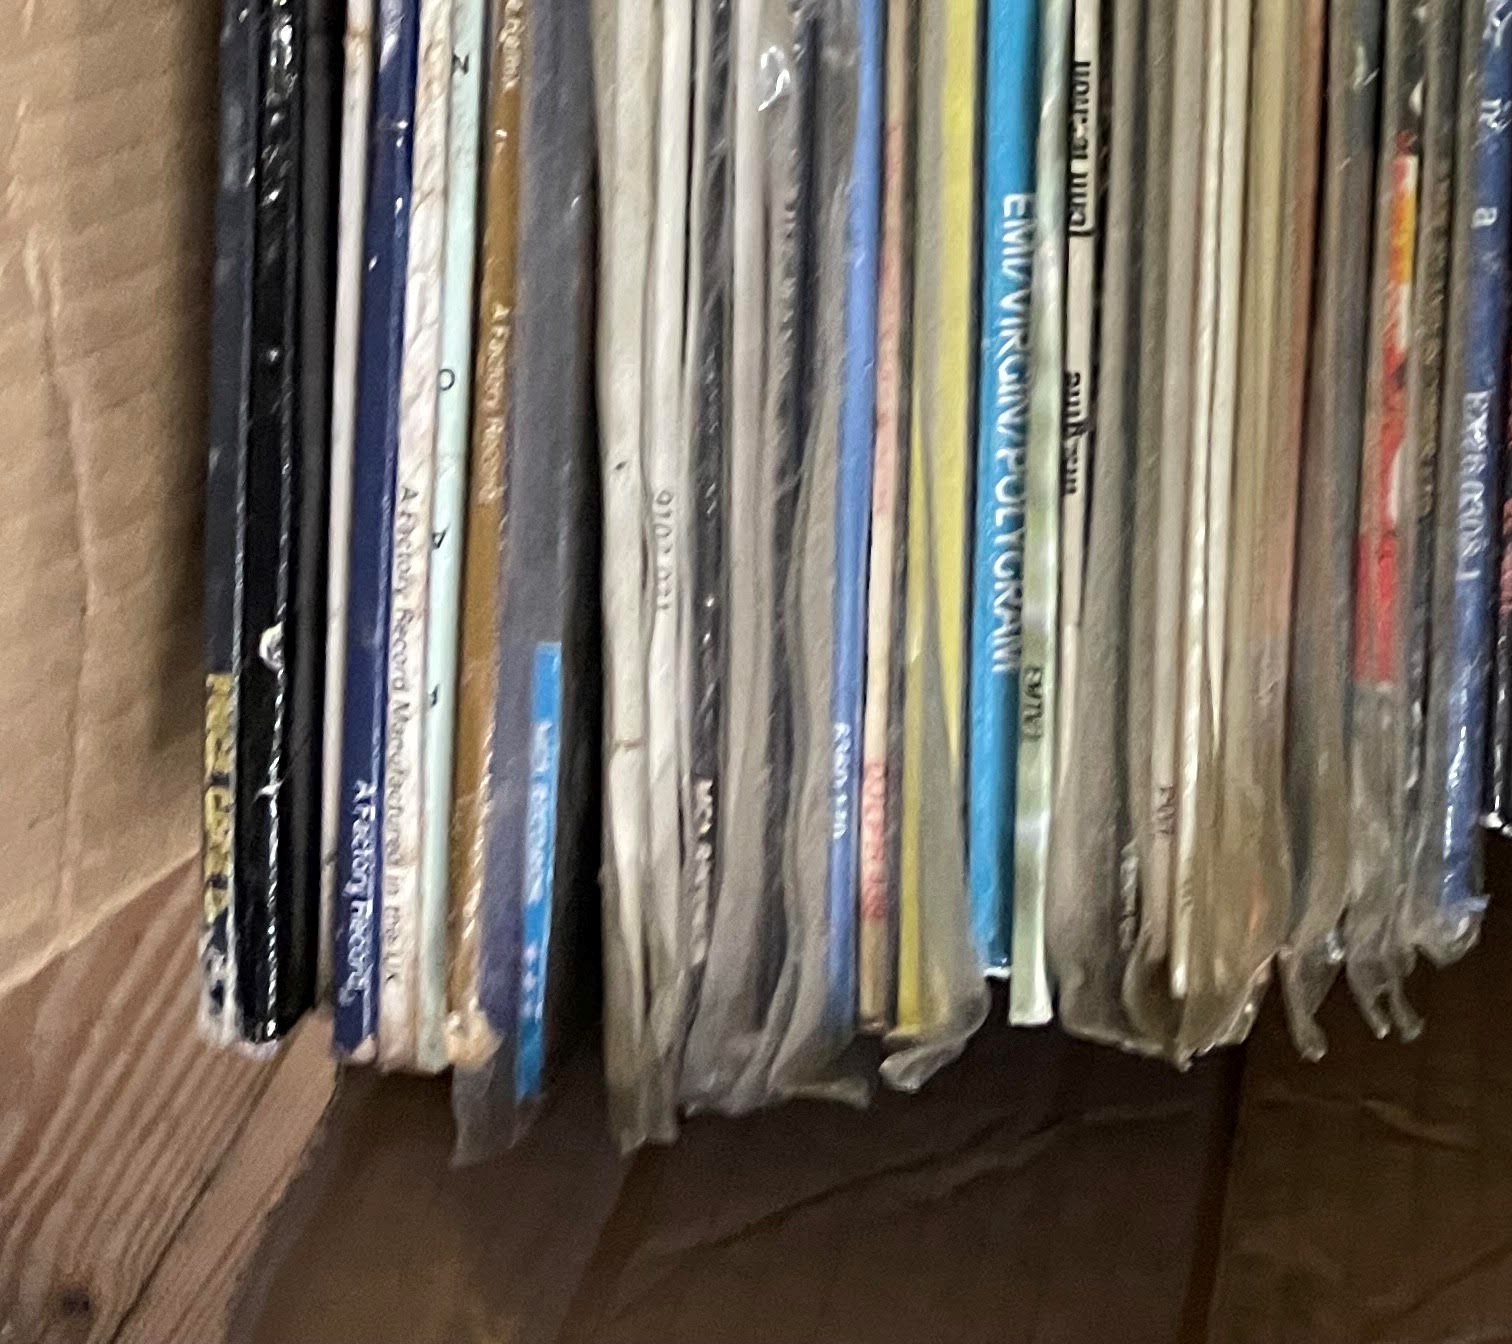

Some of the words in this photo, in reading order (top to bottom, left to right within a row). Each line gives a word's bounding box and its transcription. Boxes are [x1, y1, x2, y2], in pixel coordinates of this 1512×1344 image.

[399, 486, 420, 503] A
[393, 513, 418, 594] Factory
[391, 608, 415, 692] Record
[351, 780, 375, 800] A
[386, 699, 413, 867] Manufactured
[385, 875, 406, 897] in
[384, 906, 404, 945] the
